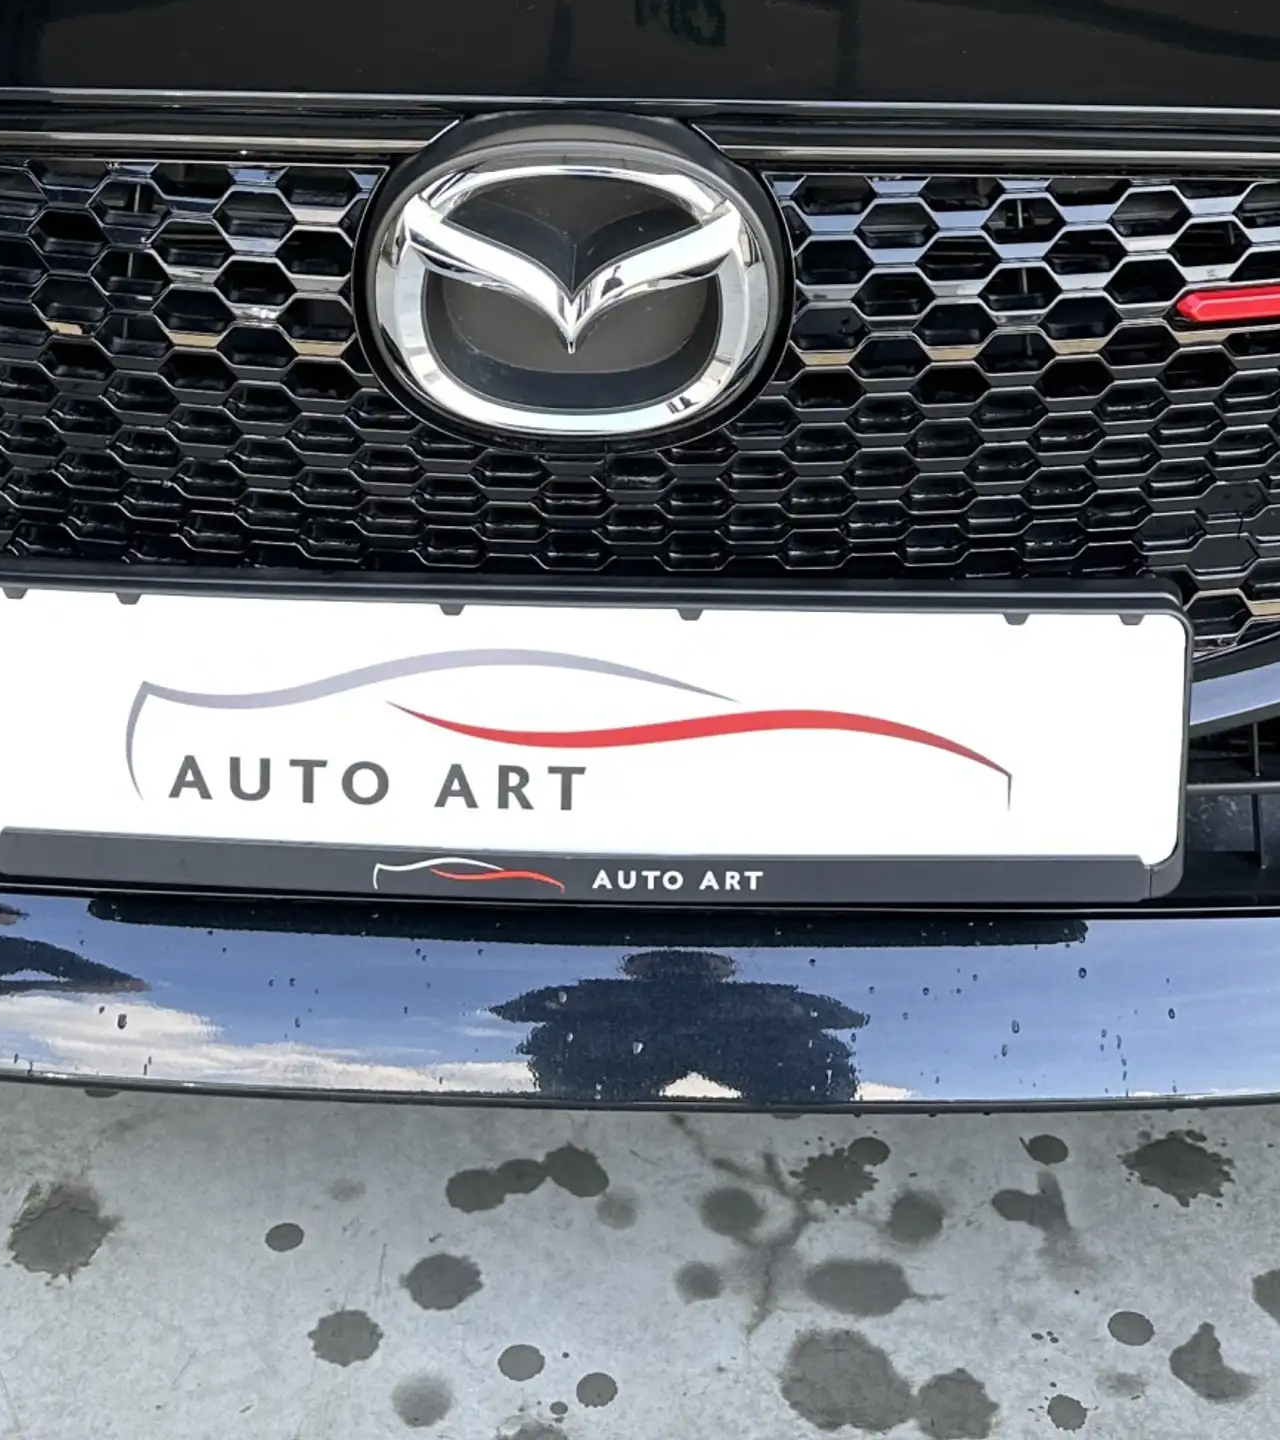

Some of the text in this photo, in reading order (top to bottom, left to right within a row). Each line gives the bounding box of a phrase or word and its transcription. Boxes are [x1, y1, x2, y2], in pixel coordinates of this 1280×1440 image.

[168, 754, 588, 811] AUTO ART
[591, 868, 765, 891] AUTO ART
